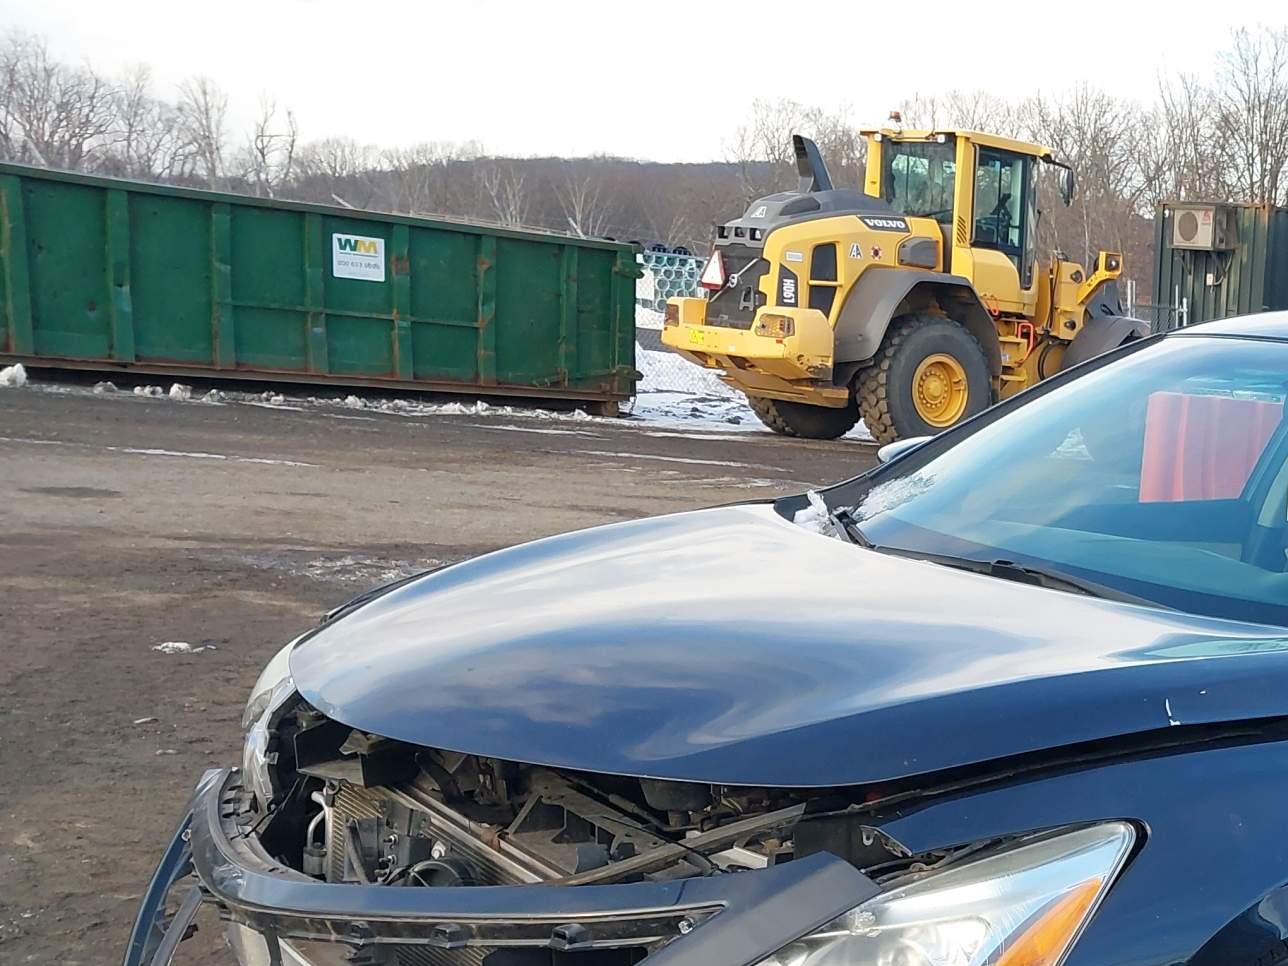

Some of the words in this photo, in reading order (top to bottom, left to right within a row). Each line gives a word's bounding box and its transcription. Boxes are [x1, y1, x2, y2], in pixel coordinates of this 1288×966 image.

[863, 218, 906, 229] VOLVO
[336, 237, 378, 254] WM
[782, 278, 795, 304] L90H
